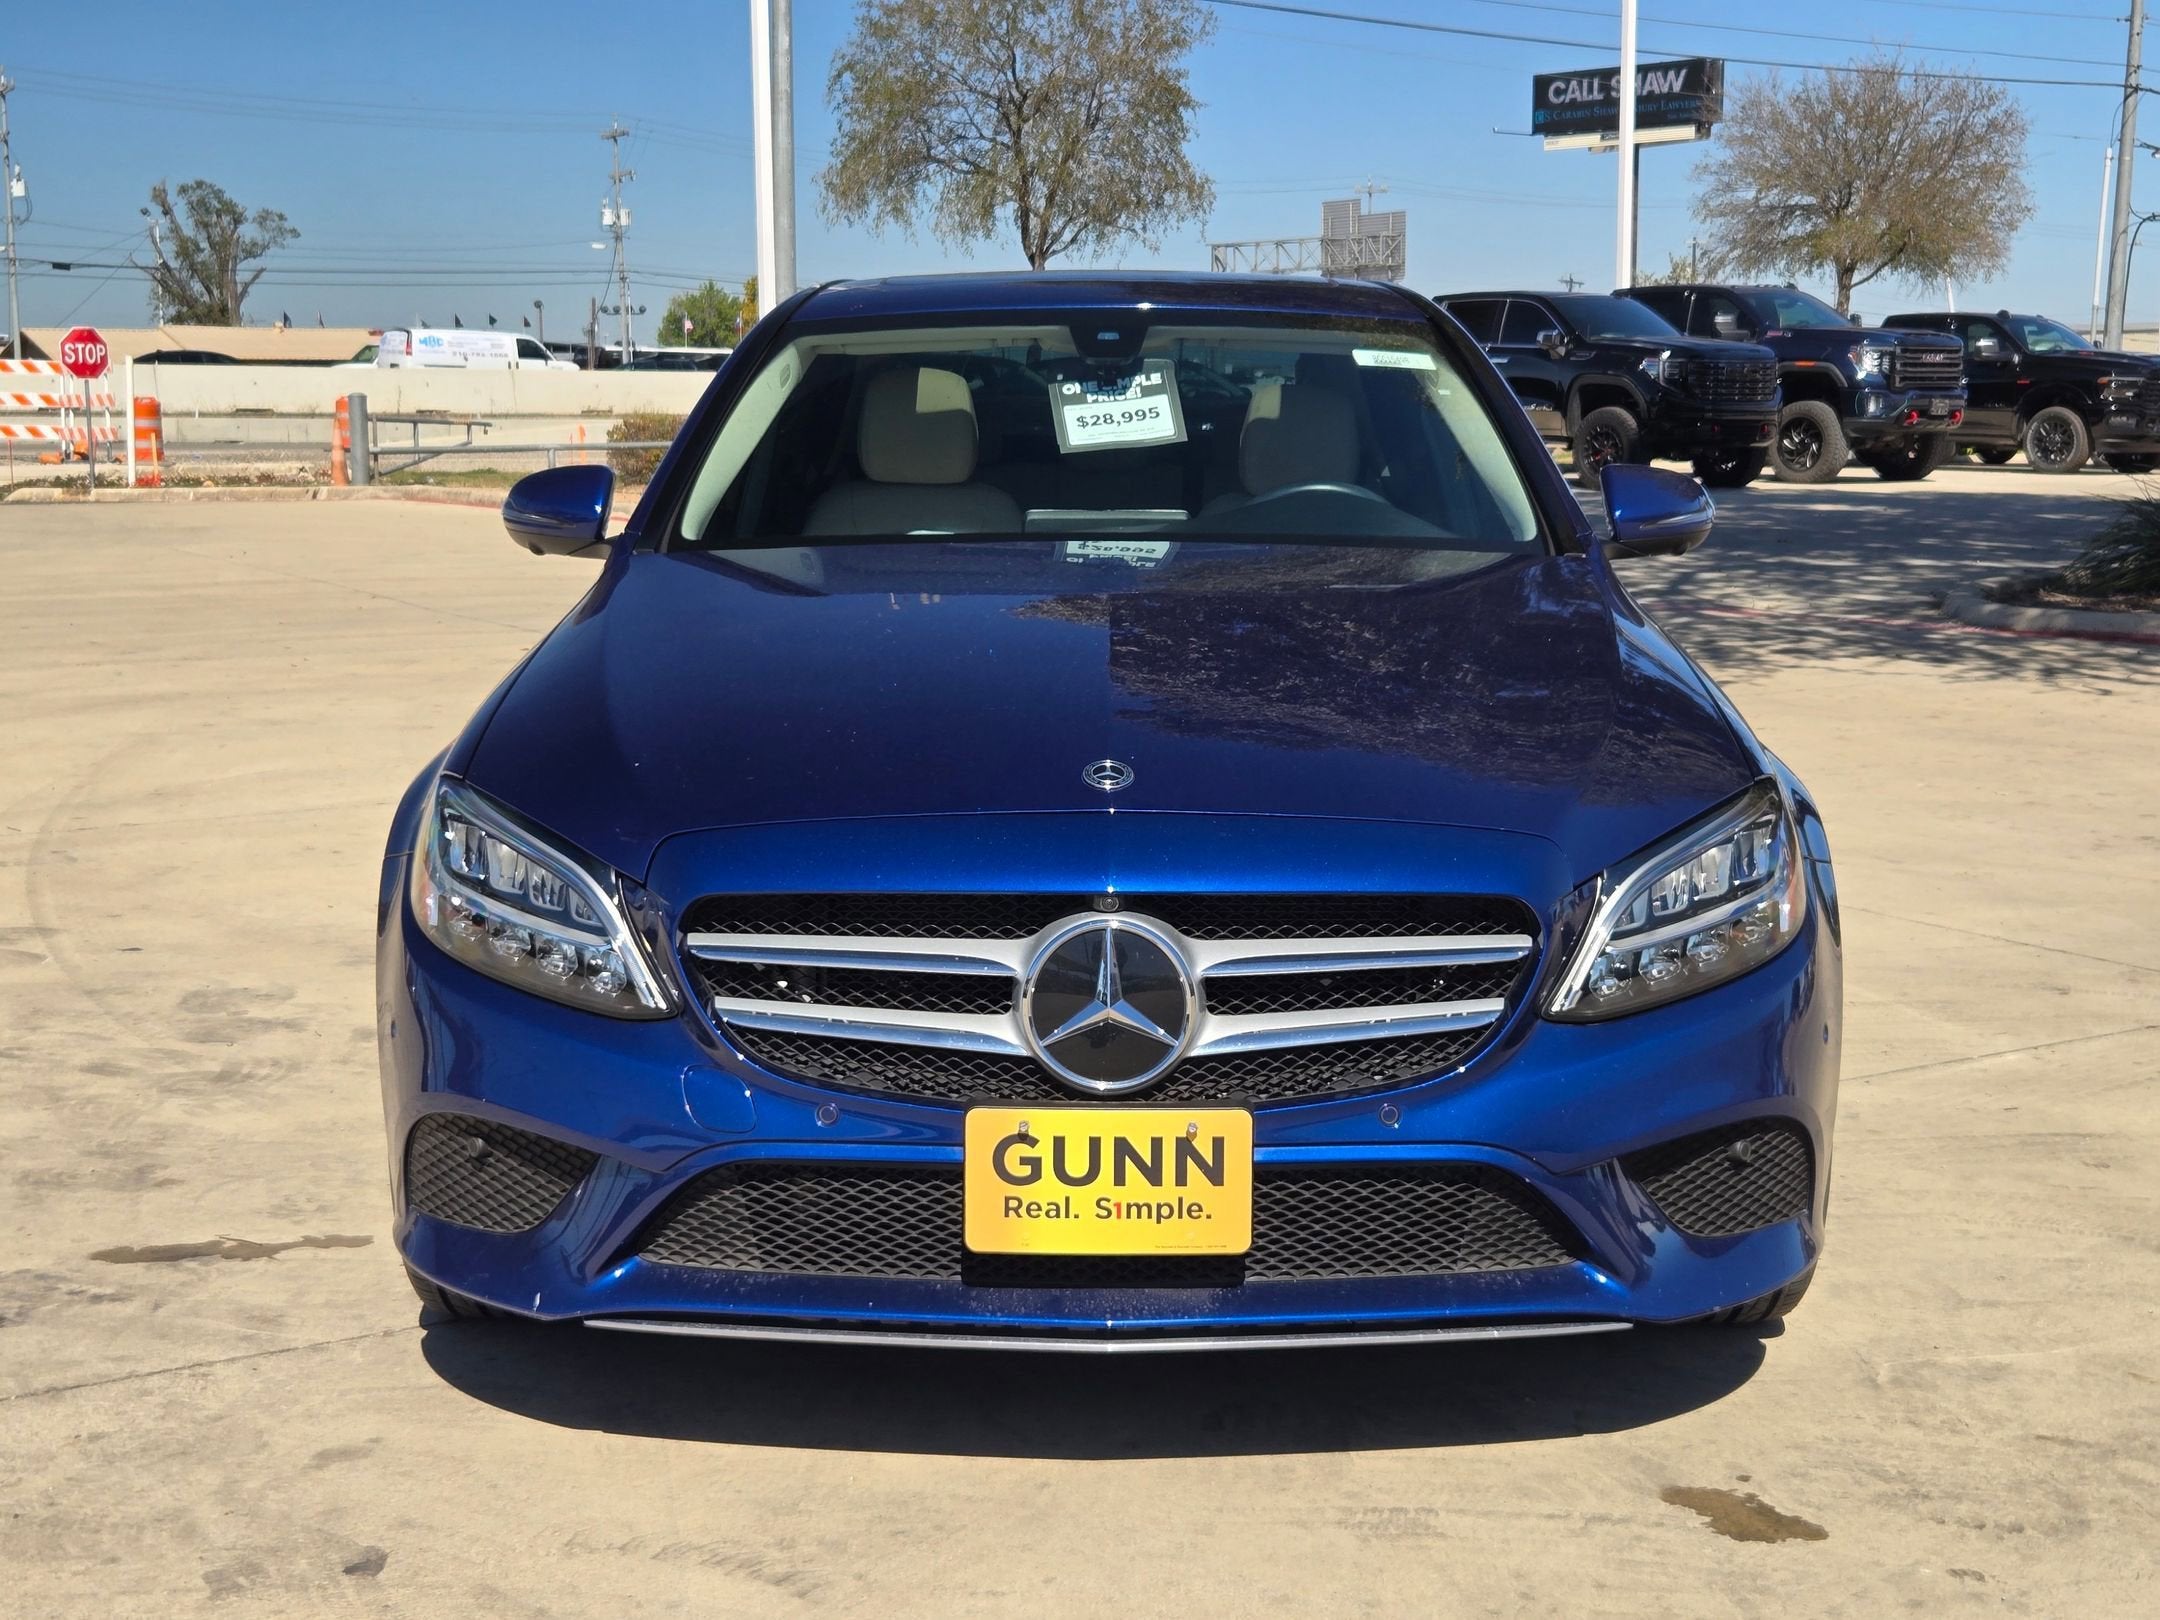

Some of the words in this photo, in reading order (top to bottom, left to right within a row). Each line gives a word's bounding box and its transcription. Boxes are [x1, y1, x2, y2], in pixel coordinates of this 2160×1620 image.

[1548, 76, 1603, 104] CALL
[64, 343, 106, 364] STOP
[1062, 379, 1099, 395] ONE
[1087, 386, 1142, 403] PRICE!
[1076, 406, 1160, 429] $28,995
[992, 1133, 1225, 1187] GUNN
[1004, 1195, 1080, 1220] Real.
